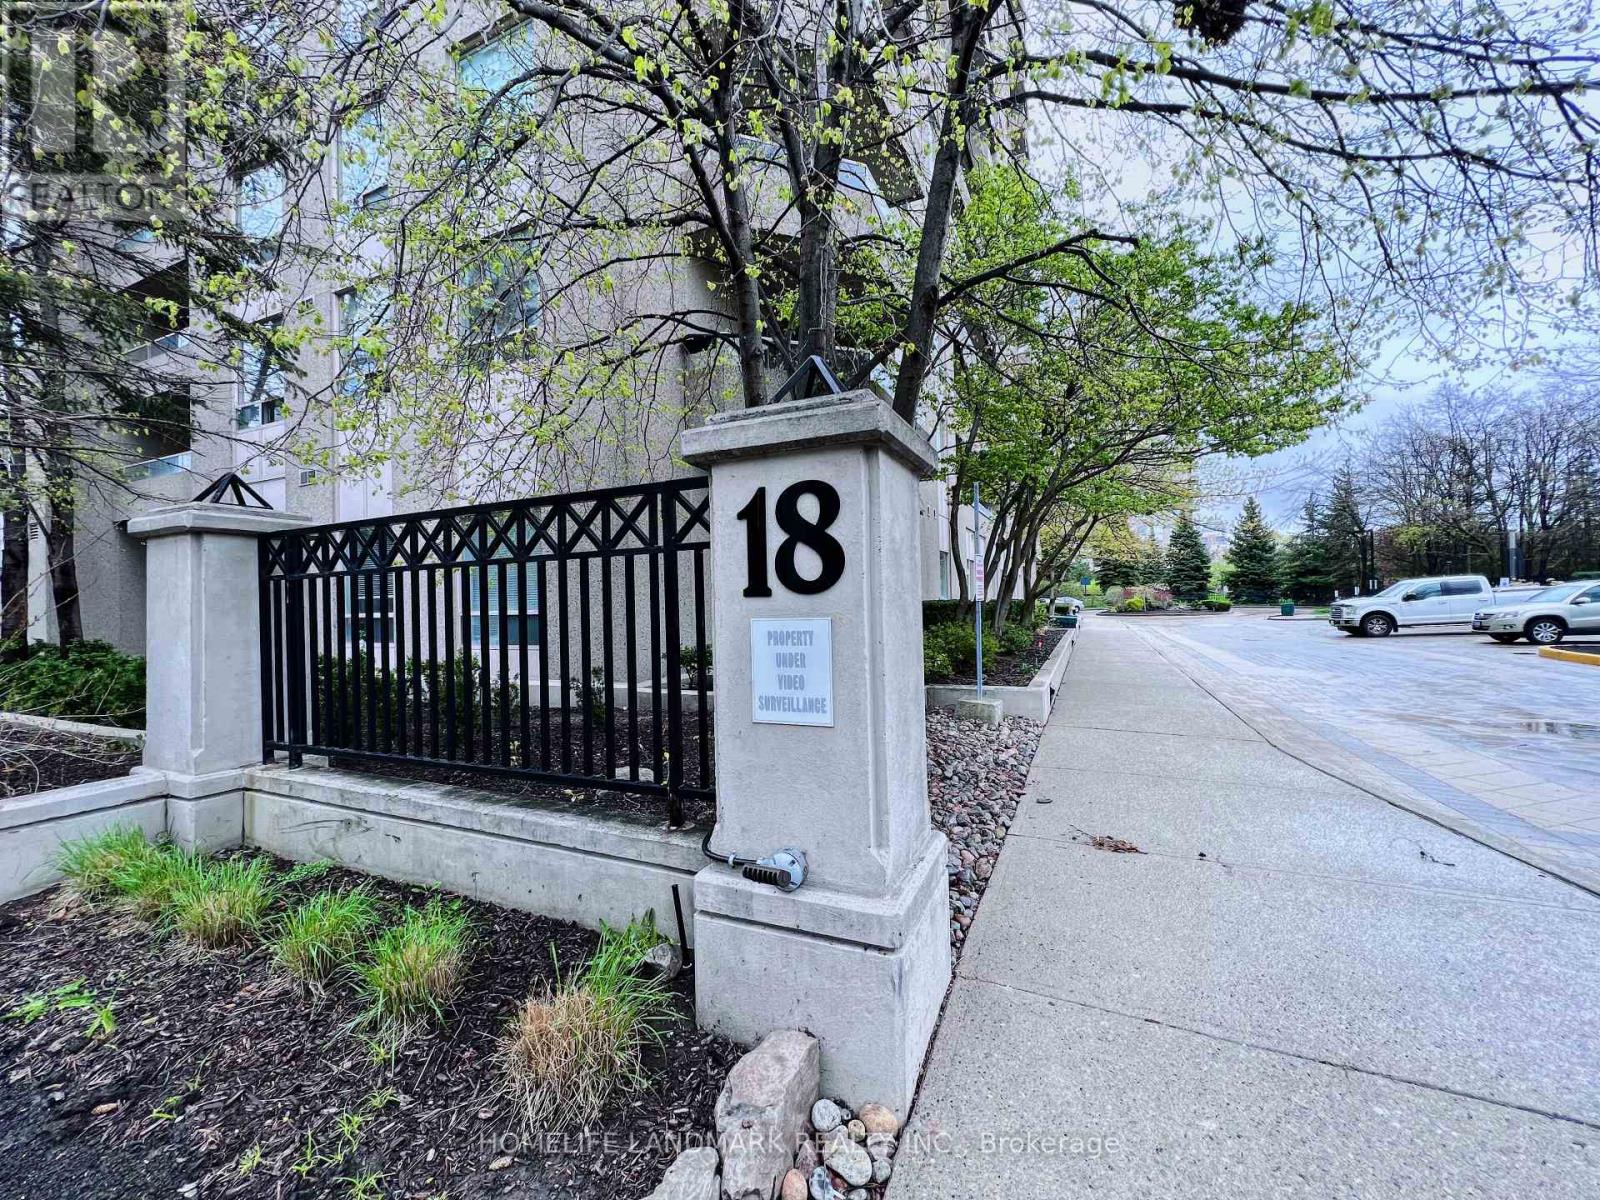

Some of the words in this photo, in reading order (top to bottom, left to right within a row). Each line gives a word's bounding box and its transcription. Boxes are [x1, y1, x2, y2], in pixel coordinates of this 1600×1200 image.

[737, 479, 846, 598] 18
[767, 630, 814, 647] PROPERTY
[775, 652, 806, 669] UNDER
[777, 674, 805, 691] VIDEO
[758, 695, 828, 714] SURVEILLANCE
